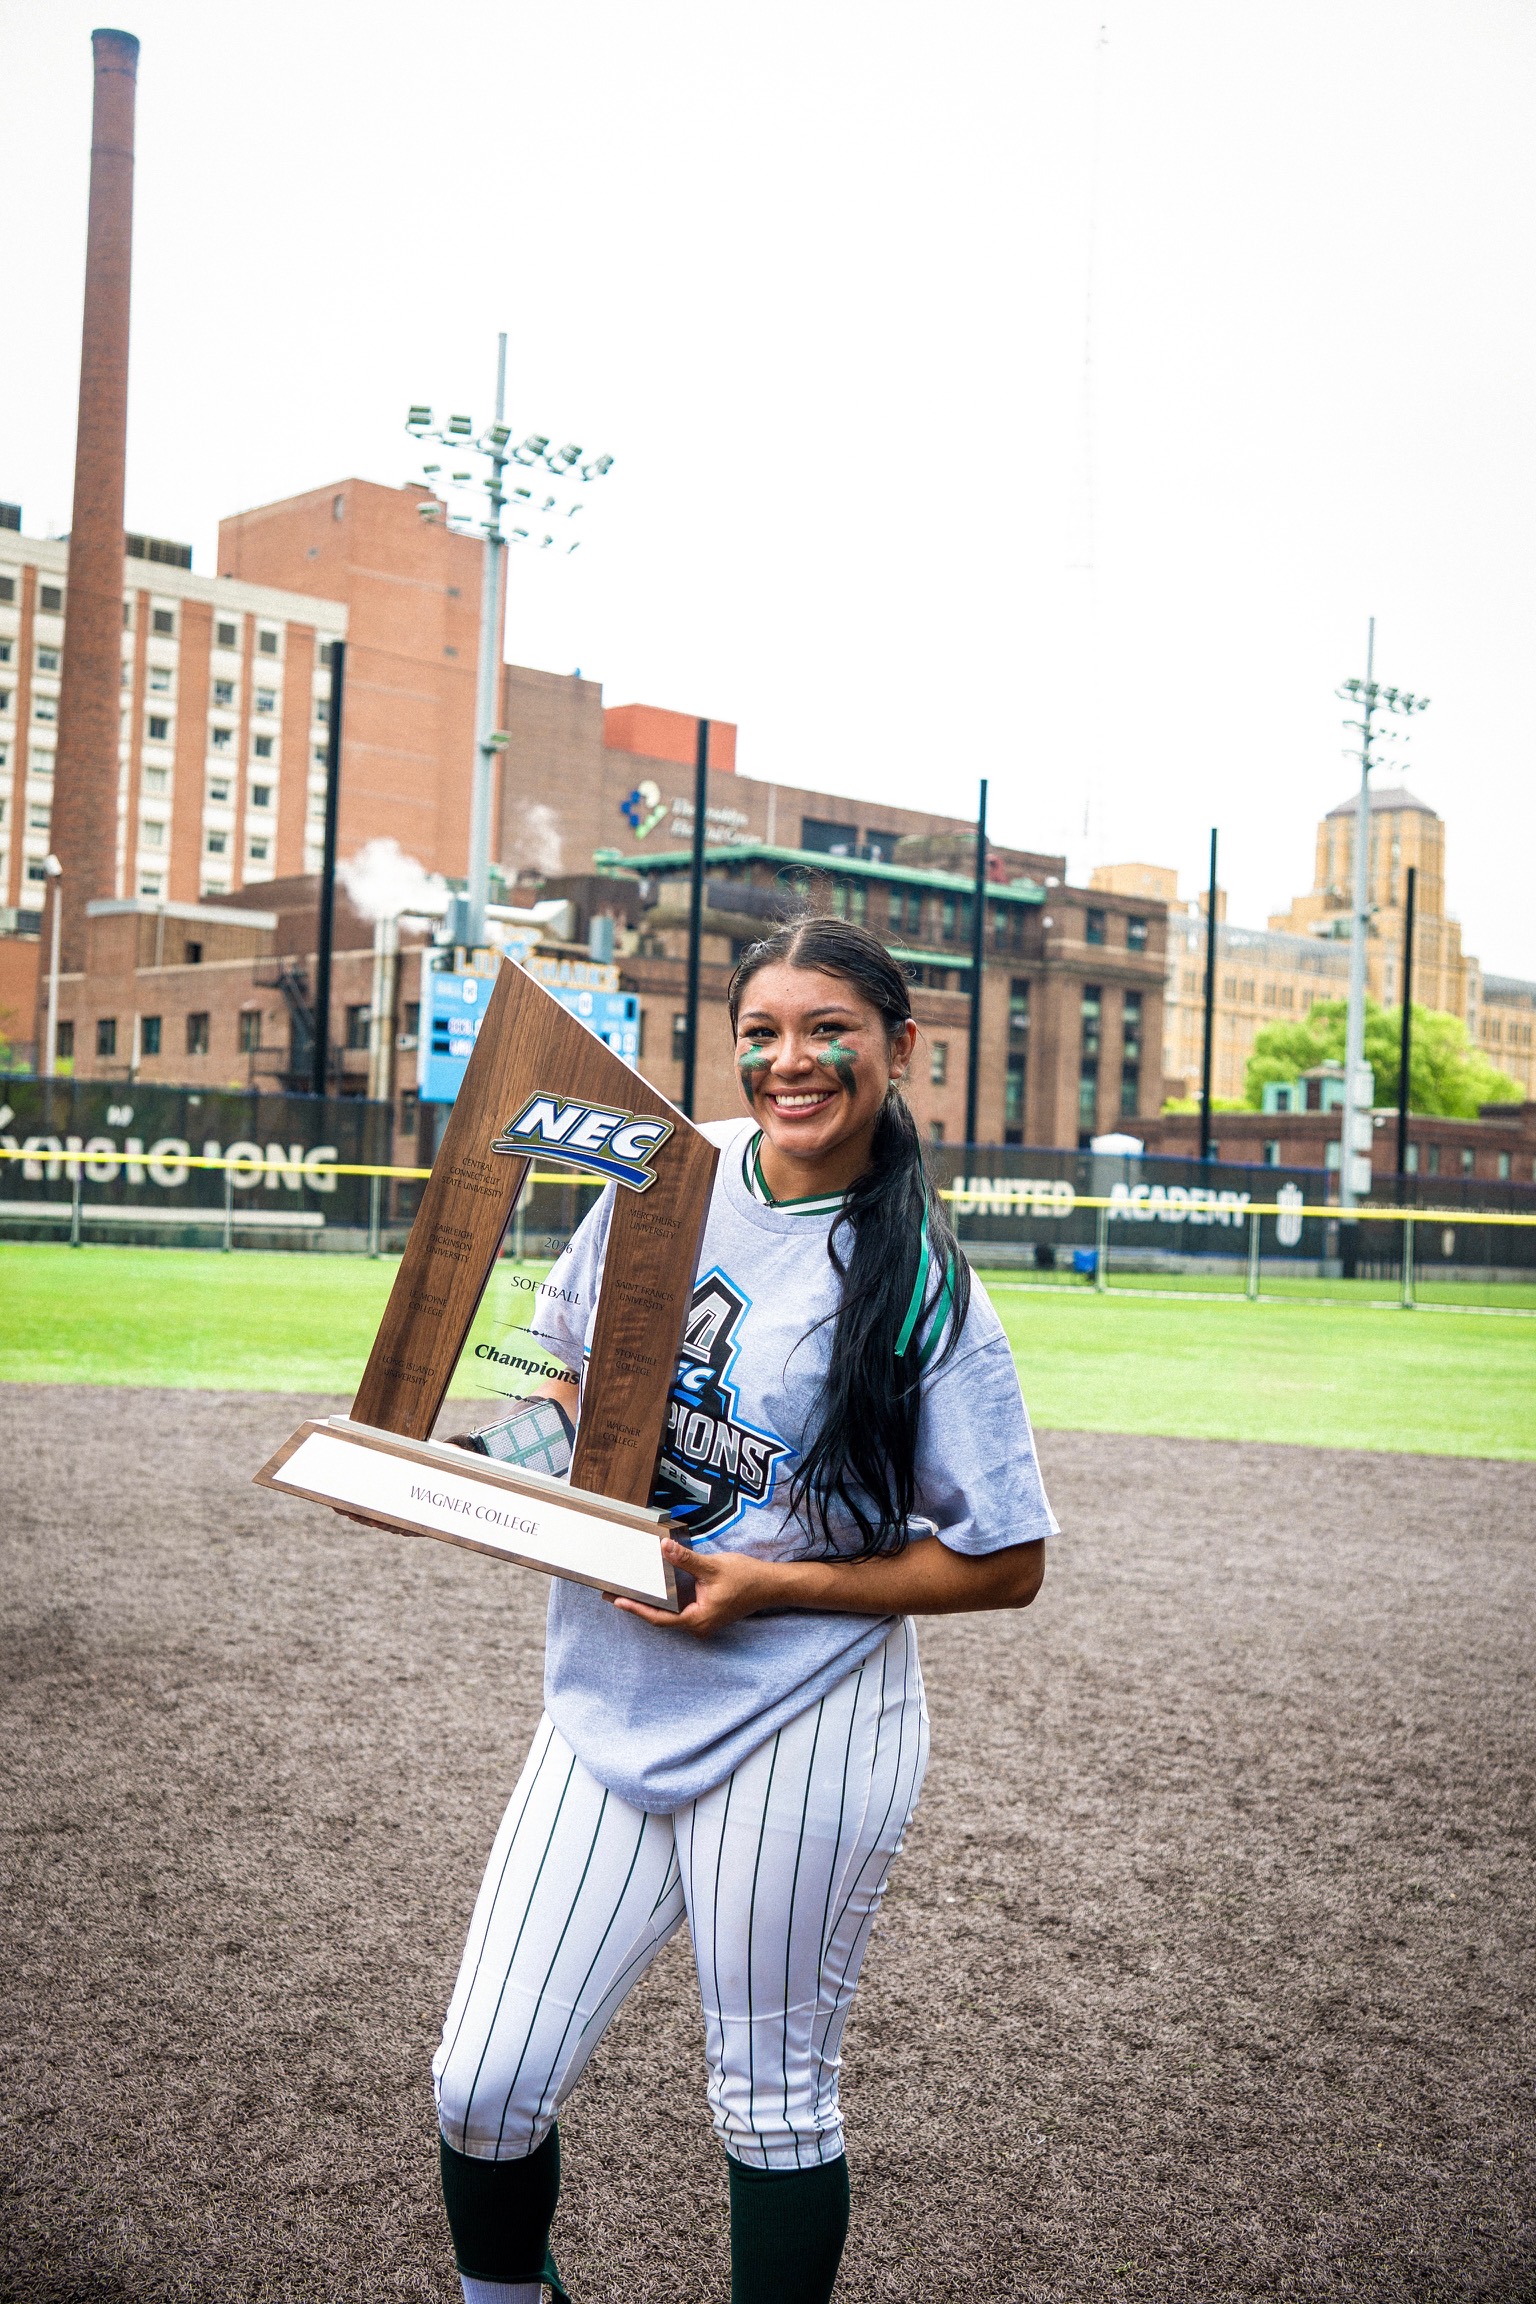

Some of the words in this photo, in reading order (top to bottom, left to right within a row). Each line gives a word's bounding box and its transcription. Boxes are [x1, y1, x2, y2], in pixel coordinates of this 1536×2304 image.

[507, 1096, 669, 1163] NEC
[462, 1157, 493, 1172] CENTRAL
[450, 1166, 501, 1186] CONNECTICUT
[441, 1175, 461, 1187] STATE
[463, 1181, 503, 1199] UNIVERSITY
[952, 1176, 1075, 1218] UNITED
[1106, 1182, 1251, 1228] ACADEMY
[629, 1208, 682, 1229] MERCYHURST
[434, 1222, 473, 1240] FAIRLEIGH
[629, 1221, 676, 1239] UNIVERSITY
[429, 1233, 472, 1251] DICKINSON
[544, 1237, 573, 1254] 2026
[426, 1245, 470, 1263] UNIVERSITY
[511, 1276, 581, 1305] SOFTBALL
[615, 1279, 640, 1293] SAINT
[641, 1286, 675, 1302] FRANCIS
[408, 1301, 443, 1318] COLLEGE
[619, 1293, 665, 1311] UNIVERSITY
[382, 1354, 404, 1368] LONG
[405, 1360, 435, 1377] ISLAND
[474, 1344, 581, 1385] Champions
[615, 1348, 658, 1366] STONEHILL
[384, 1368, 428, 1386] UNIVERSITY
[615, 1361, 651, 1377] COLLEGE
[606, 1419, 641, 1437] WAGNER
[603, 1432, 638, 1449] COLLEGE
[410, 1485, 472, 1516] WAGNER
[475, 1505, 540, 1536] COLLEGE
